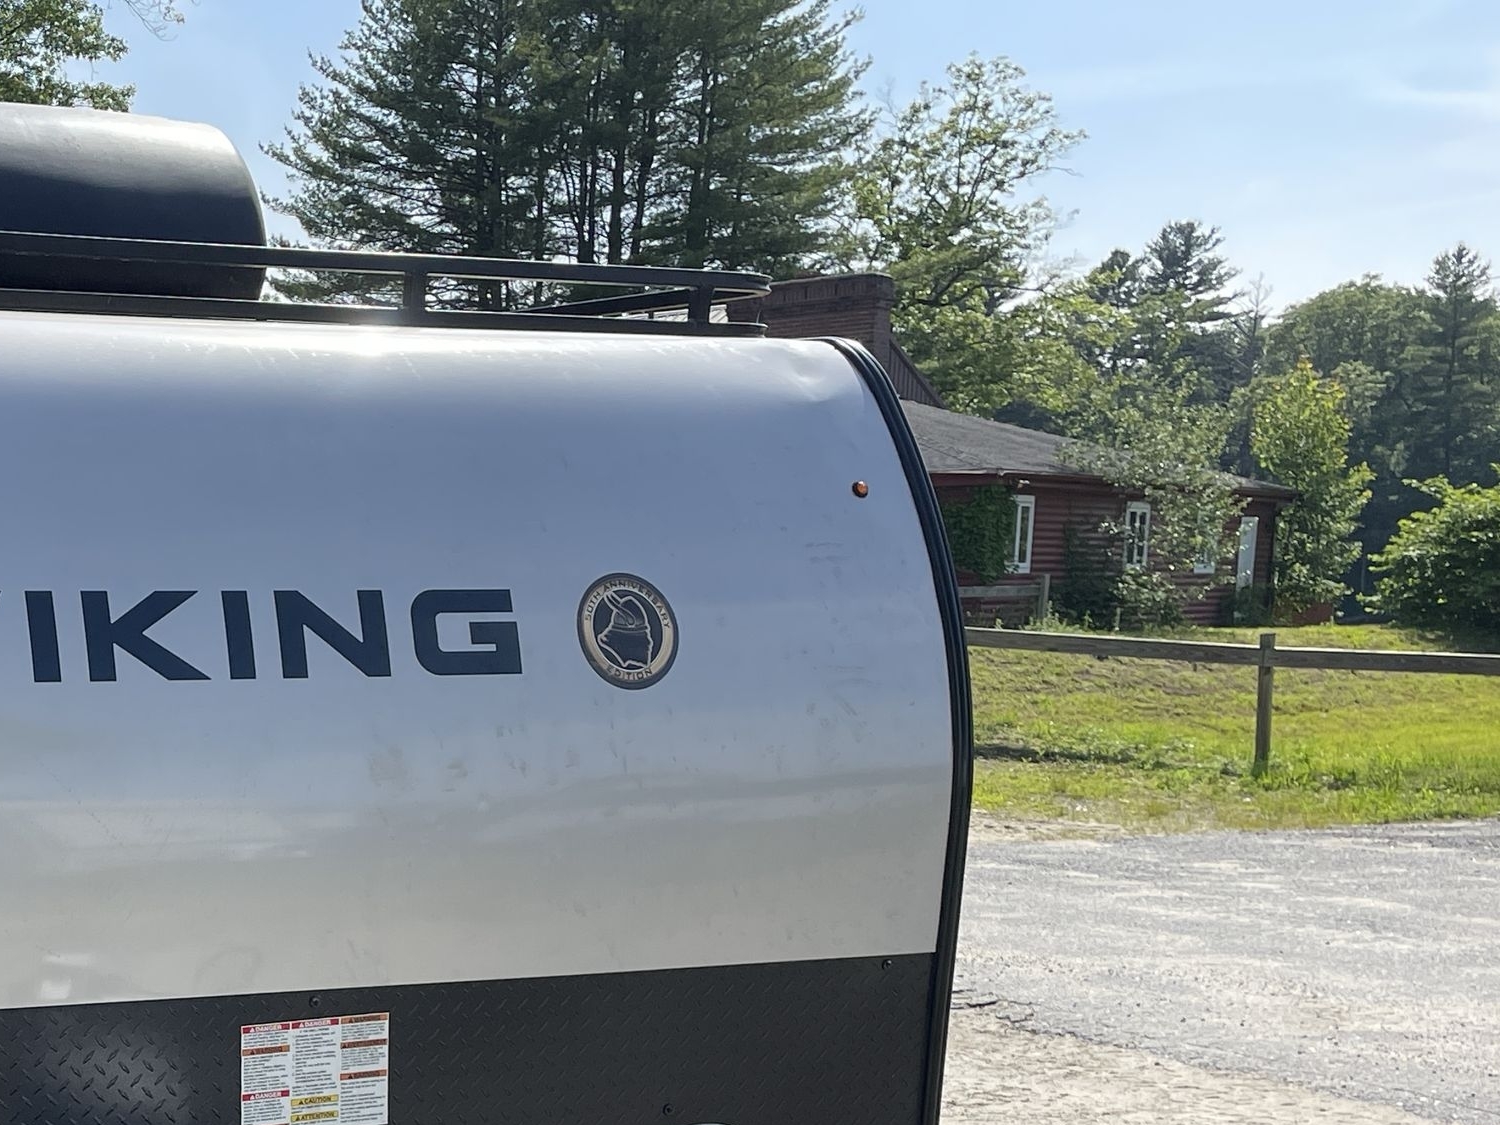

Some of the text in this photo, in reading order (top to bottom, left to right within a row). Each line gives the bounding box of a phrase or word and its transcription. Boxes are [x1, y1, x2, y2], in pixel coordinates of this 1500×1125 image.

[606, 664, 653, 680] EDITION
[255, 1091, 282, 1099] DANGER
[304, 1096, 332, 1104] CAUTION
